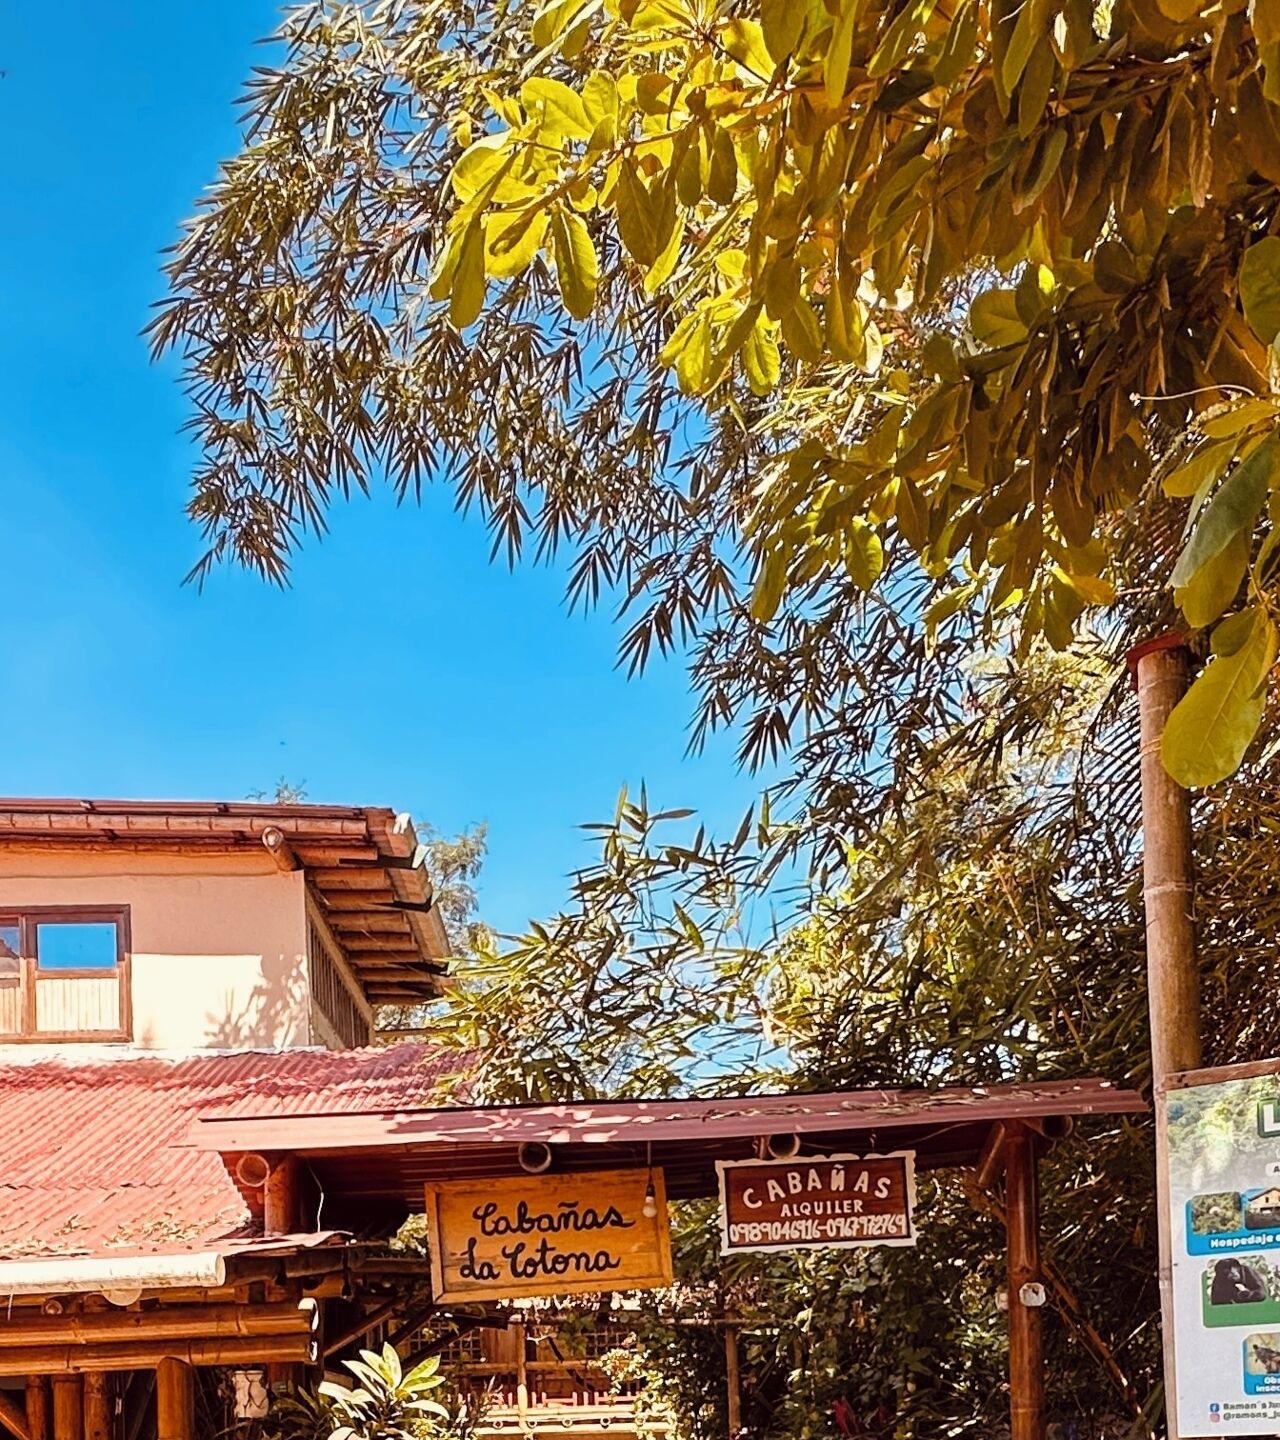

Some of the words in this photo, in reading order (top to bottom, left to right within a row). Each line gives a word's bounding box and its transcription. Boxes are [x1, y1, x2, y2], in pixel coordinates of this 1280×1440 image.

[742, 1164, 892, 1210] CABAÑAS
[472, 1200, 637, 1236] Cabañas
[780, 1199, 864, 1218] ALQUILER
[459, 1237, 500, 1280] La
[502, 1238, 621, 1278] Cotona
[1210, 1232, 1273, 1249] Hospedaje
